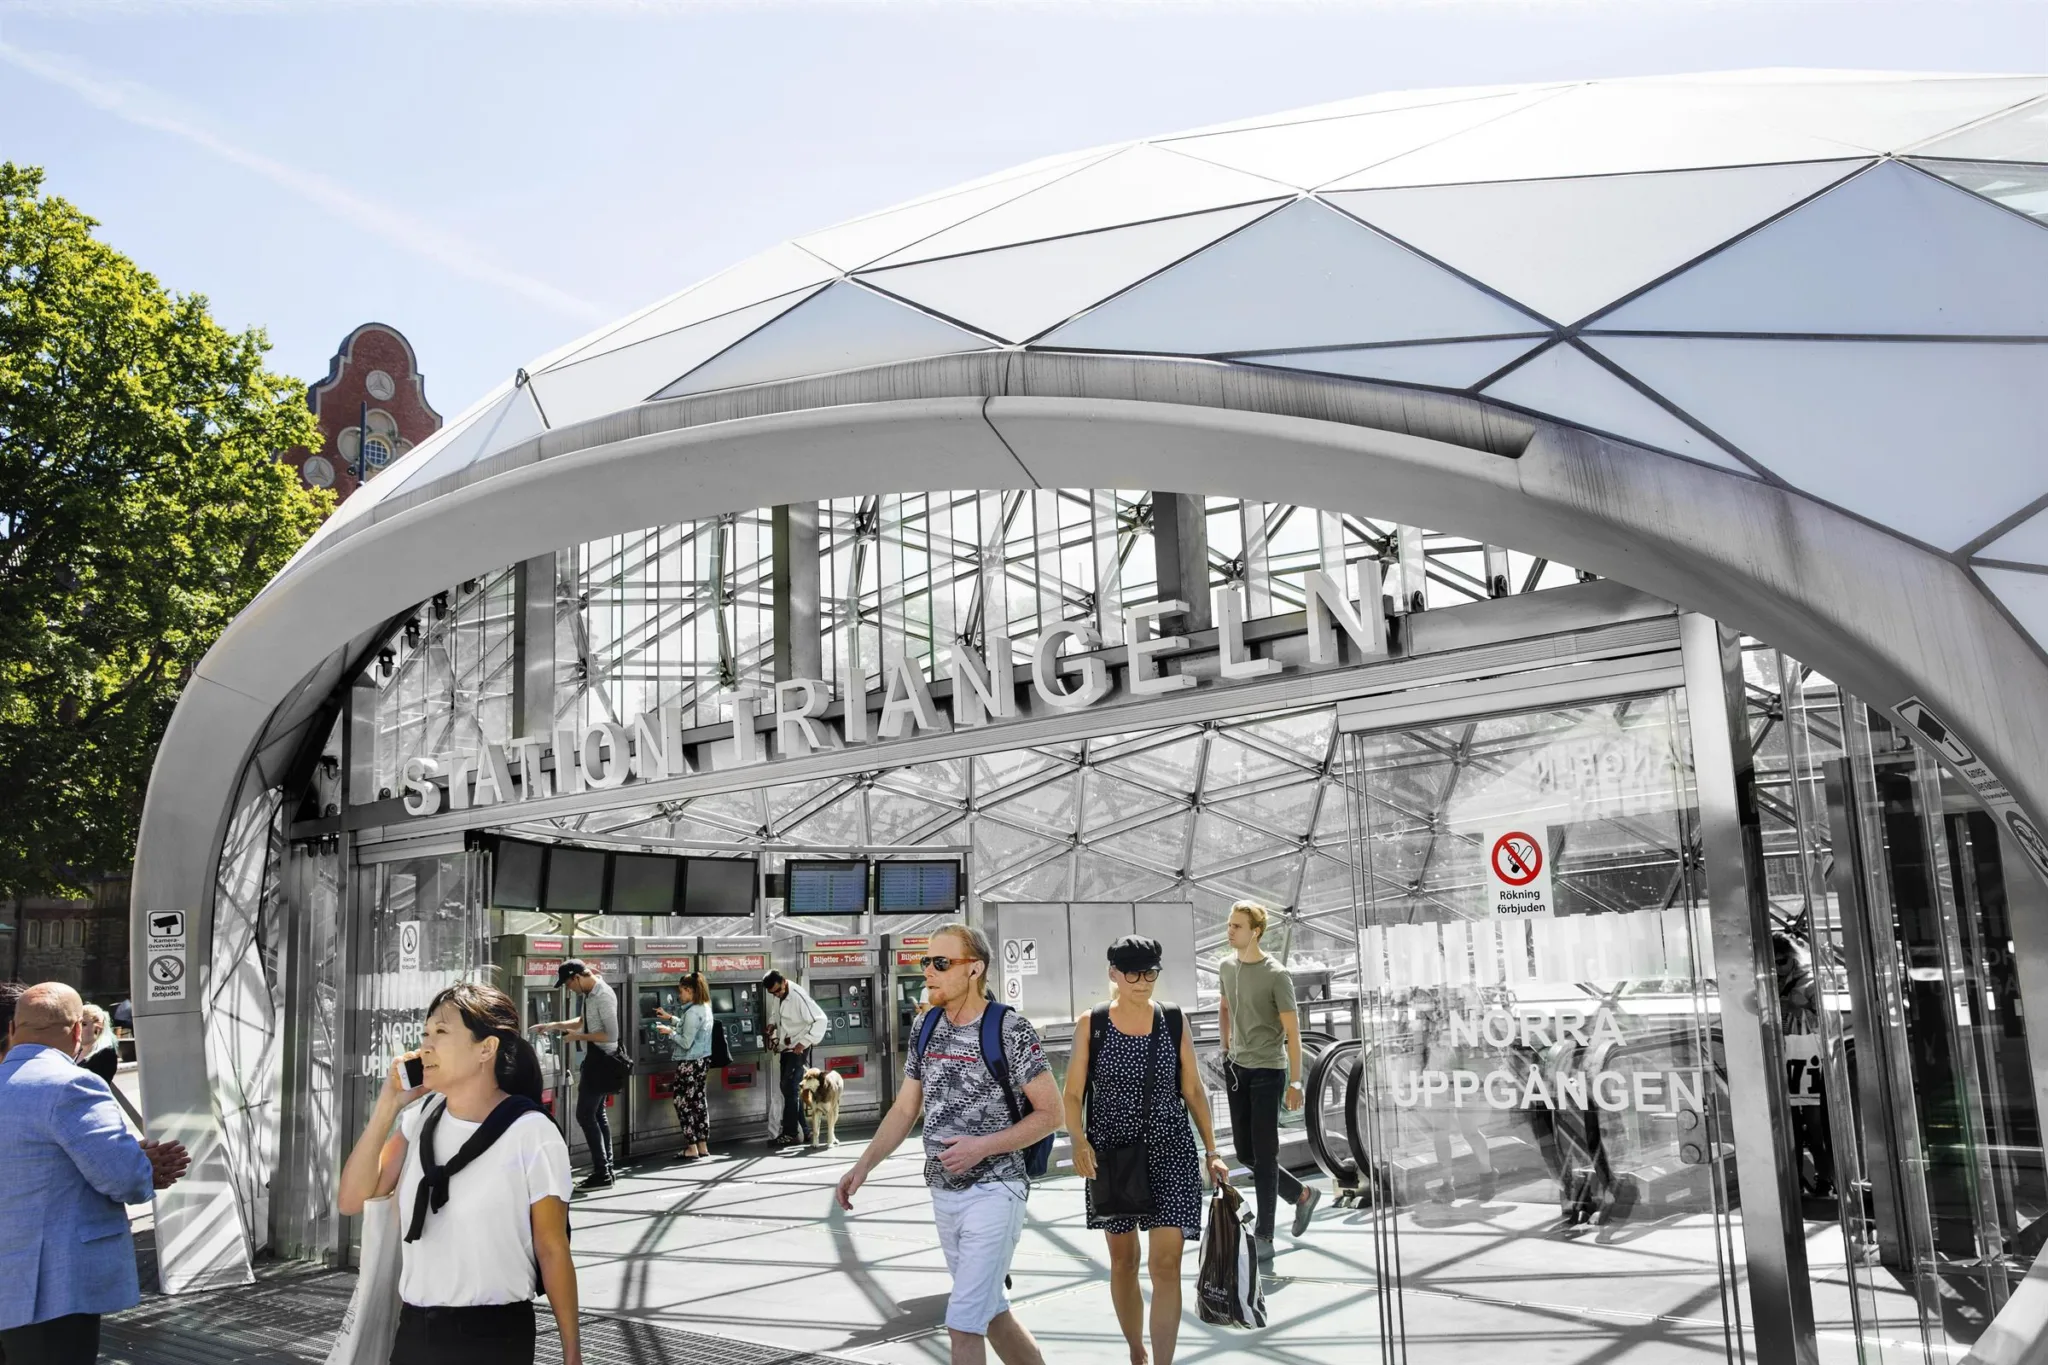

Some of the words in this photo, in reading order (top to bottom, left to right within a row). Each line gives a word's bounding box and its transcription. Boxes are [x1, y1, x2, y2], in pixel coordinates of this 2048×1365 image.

[403, 706, 685, 816] STATION
[718, 559, 1388, 763] TRIANGELN
[1500, 890, 1540, 900] Rökning
[1497, 903, 1546, 915] förbjuden
[667, 960, 686, 968] Tickets
[813, 955, 839, 965] Biljetter
[844, 955, 868, 963] Tickets
[382, 1022, 424, 1045] NORR
[1450, 1007, 1627, 1049] NORRA
[1389, 1064, 1706, 1113] UPPGÅNGEN
